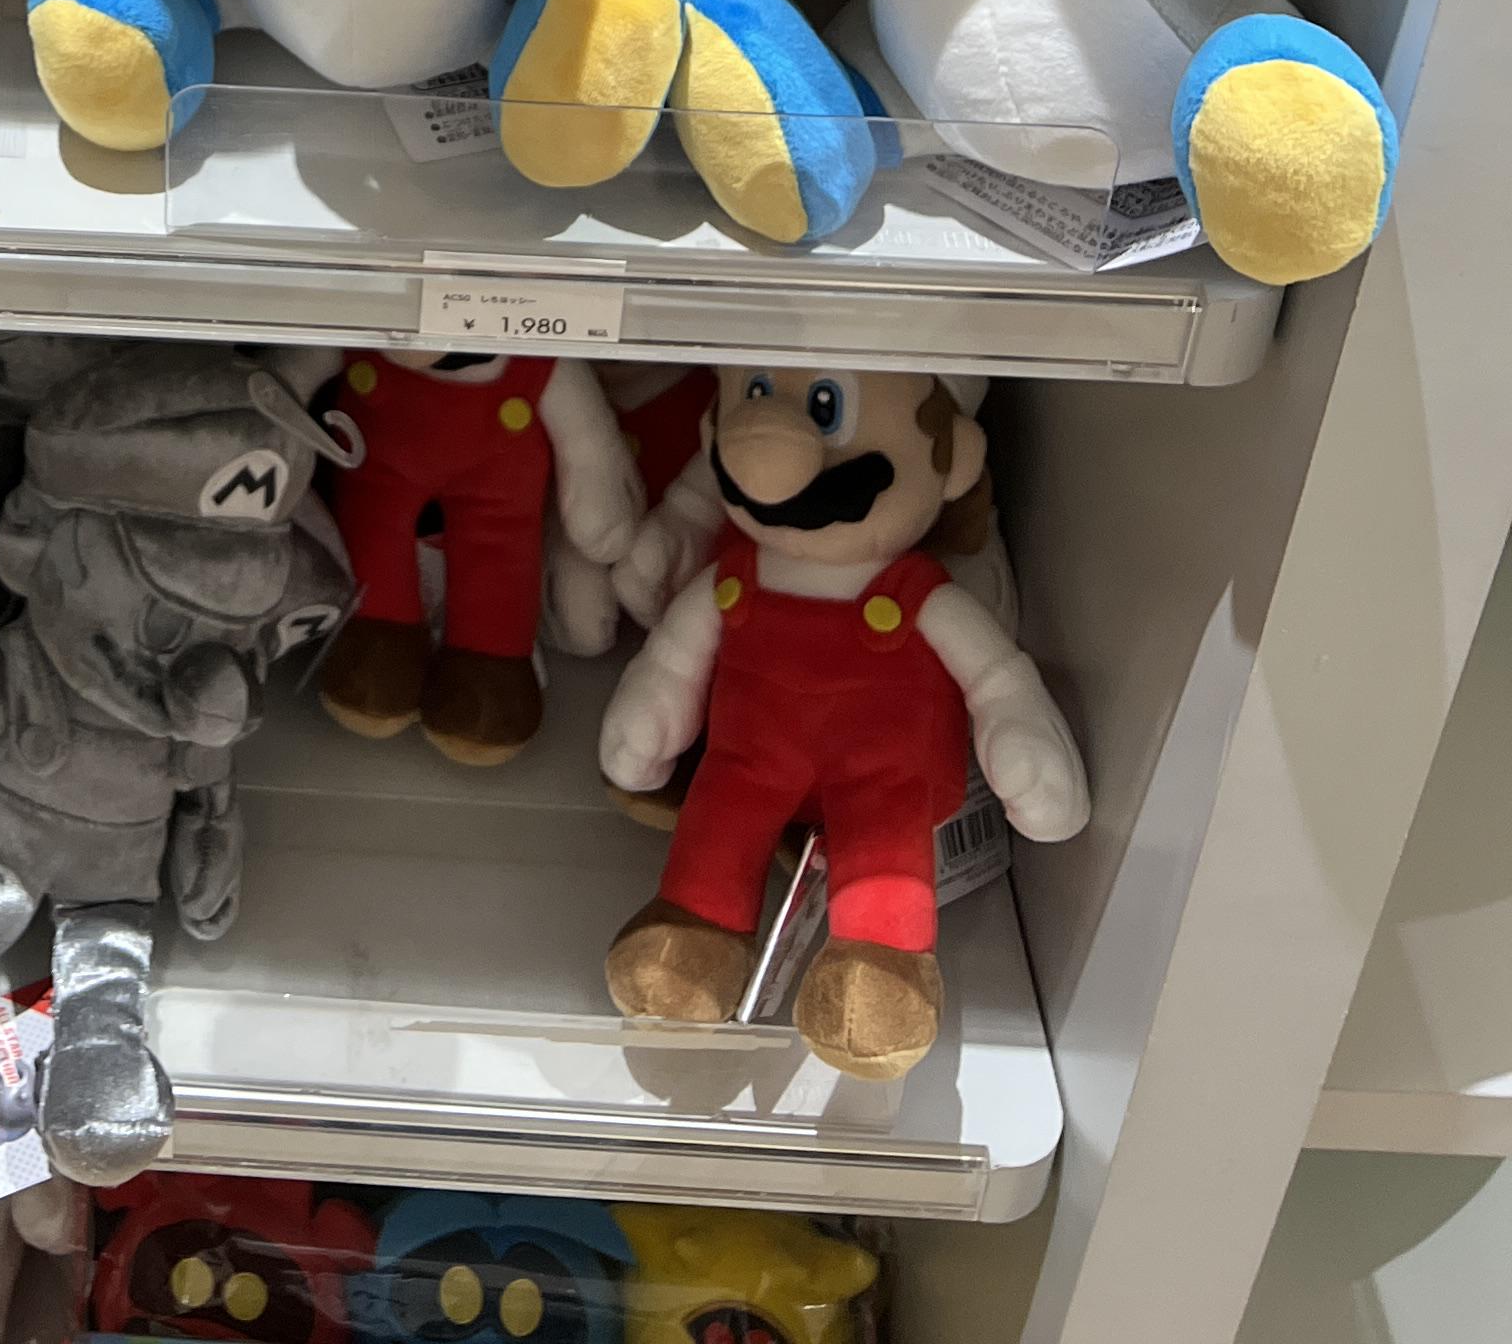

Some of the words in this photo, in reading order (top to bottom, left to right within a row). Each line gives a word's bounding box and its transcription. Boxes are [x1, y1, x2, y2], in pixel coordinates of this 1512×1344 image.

[463, 318, 476, 330] ¥
[501, 317, 567, 335] 1,980
[212, 464, 278, 509] M
